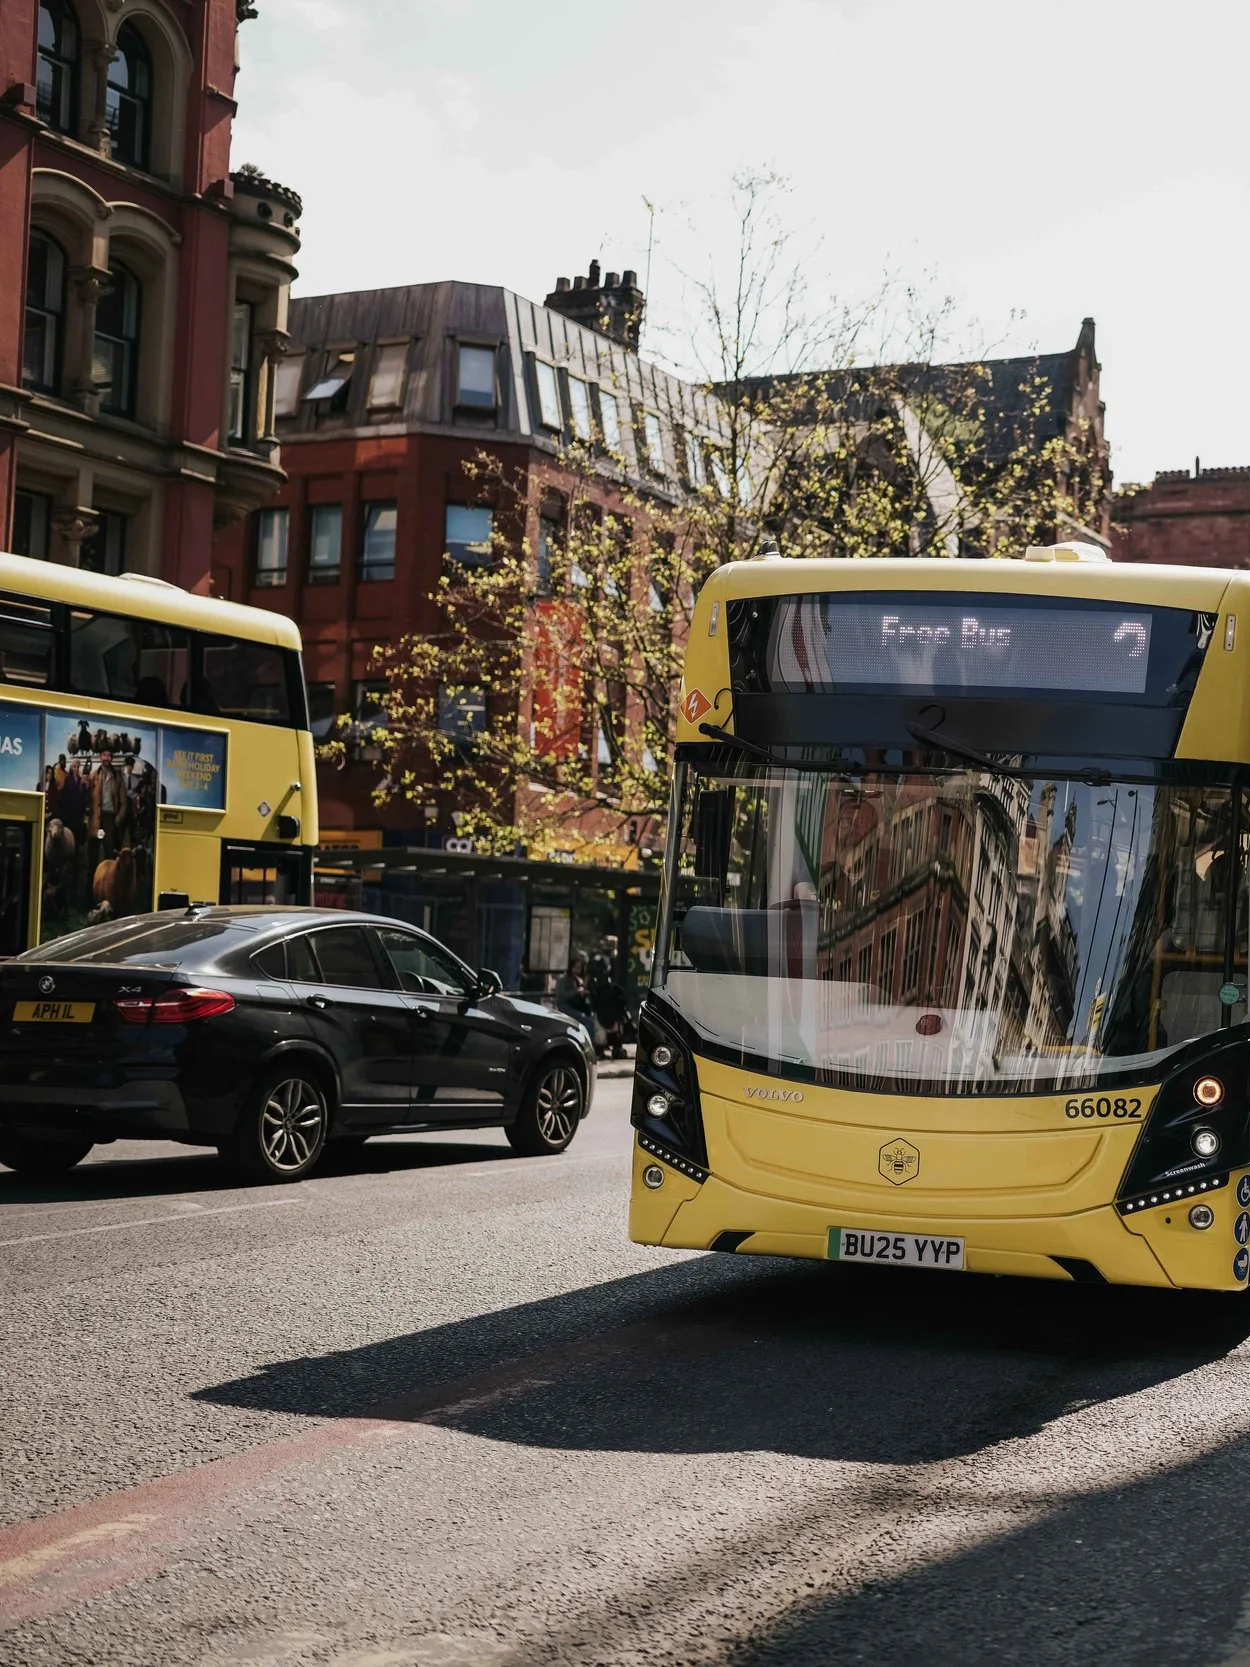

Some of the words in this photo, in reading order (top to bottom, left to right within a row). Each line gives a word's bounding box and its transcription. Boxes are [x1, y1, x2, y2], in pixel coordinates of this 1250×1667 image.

[881, 616, 950, 646] Free
[961, 618, 1011, 648] Bus
[0, 736, 23, 755] AS
[189, 762, 220, 772] HOLIDAY
[31, 1003, 60, 1019] APH
[743, 1087, 804, 1102] VOLVO
[1065, 1098, 1142, 1118] 66082
[1164, 1162, 1206, 1177] Screenwash
[844, 1233, 906, 1260] BU25
[914, 1239, 960, 1264] YYP
